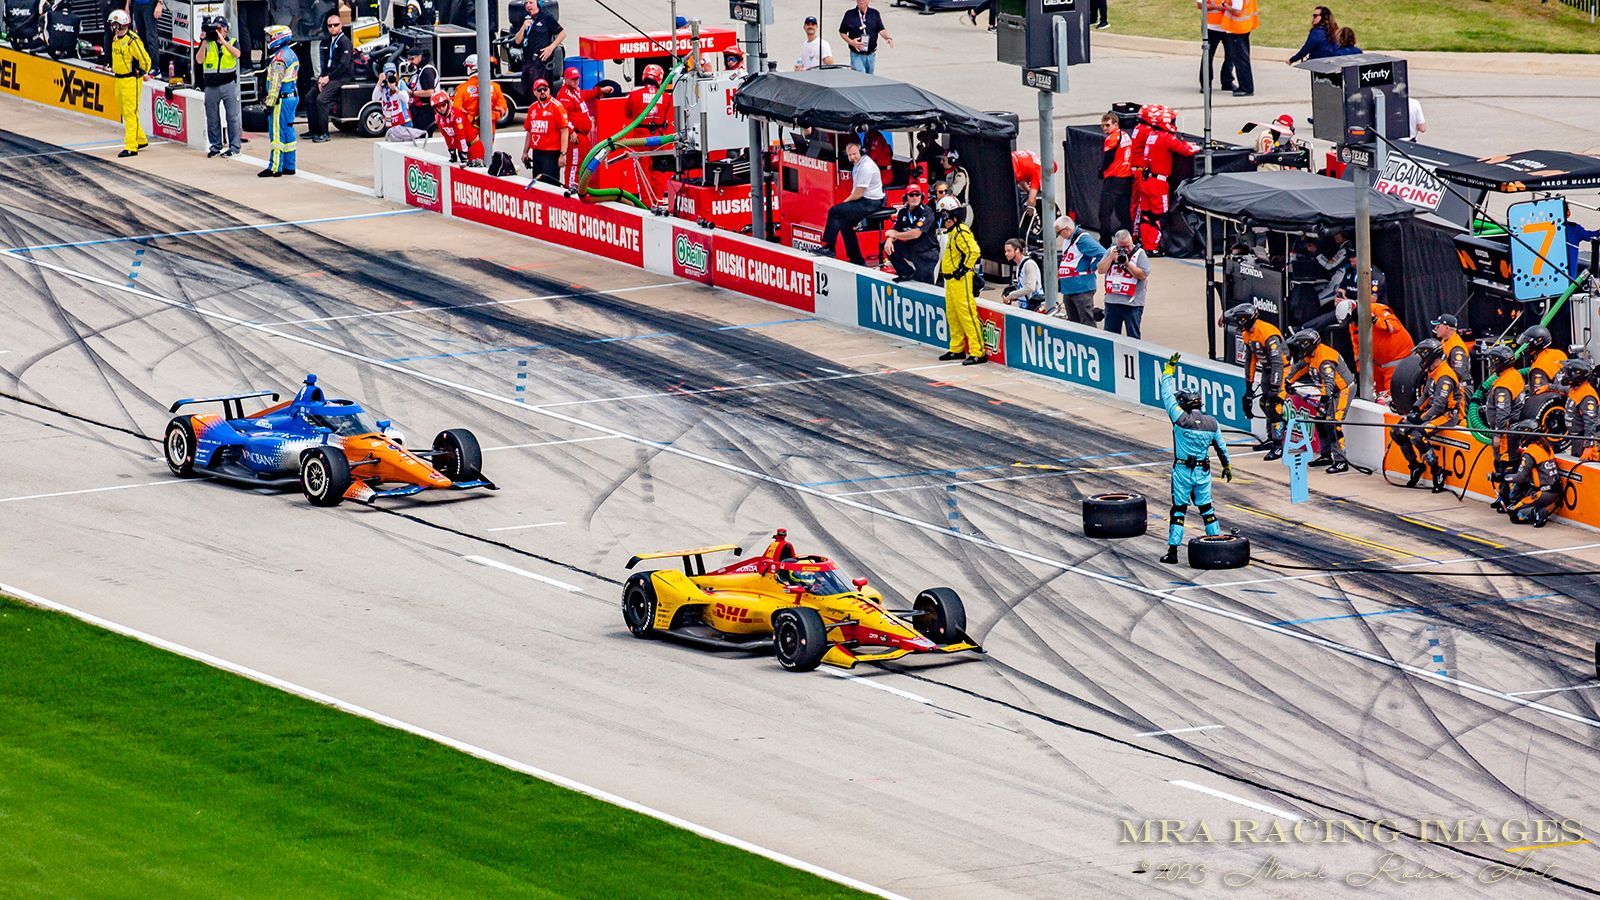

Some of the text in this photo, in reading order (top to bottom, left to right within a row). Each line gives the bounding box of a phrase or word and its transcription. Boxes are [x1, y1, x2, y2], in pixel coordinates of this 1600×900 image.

[620, 37, 715, 54] HUSKI CHOCOLTE
[0, 60, 20, 91] EL
[1036, 74, 1052, 86] TEXAS
[1361, 68, 1391, 81] xfinity
[60, 67, 104, 112] XPEL
[1352, 150, 1369, 162] TEXAS
[408, 167, 437, 202] O'Reilly
[1375, 180, 1439, 206] RACING
[453, 181, 640, 252] HUSKI CHOCOLATE HUSKI CHOCOLATE
[676, 195, 696, 215] USKI
[676, 235, 709, 273] O'Reilly
[1521, 221, 1557, 276] 7
[715, 250, 812, 297] HUSKI CHOCOLATE
[816, 271, 829, 297] 12
[1240, 266, 1263, 279] HONDA
[871, 282, 948, 342] Niterra
[1021, 323, 1100, 382] Niterra
[1123, 354, 1136, 380] 11
[715, 602, 753, 624] DHL
